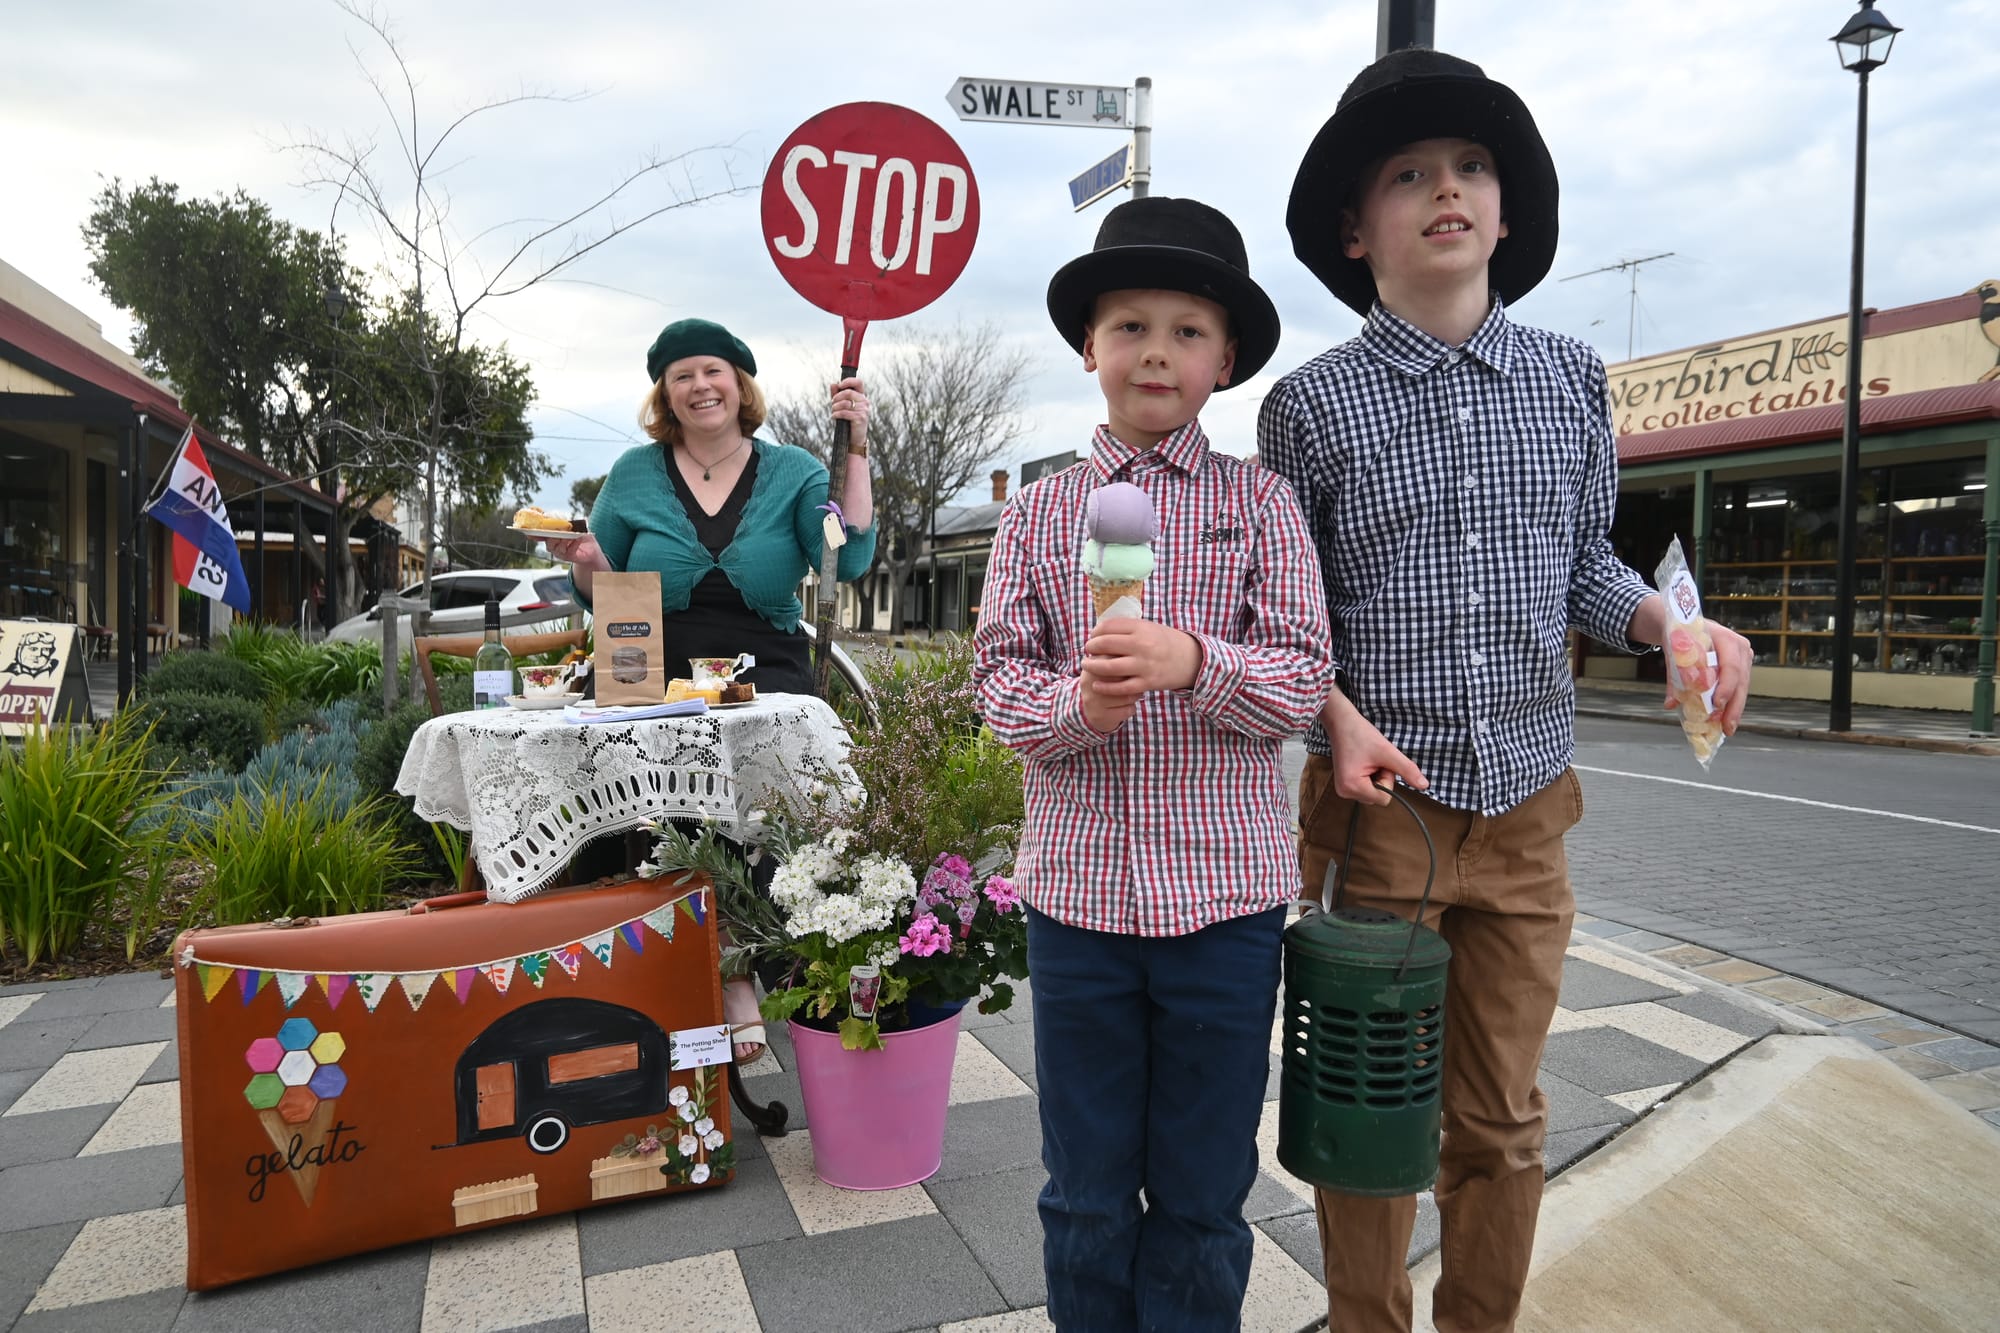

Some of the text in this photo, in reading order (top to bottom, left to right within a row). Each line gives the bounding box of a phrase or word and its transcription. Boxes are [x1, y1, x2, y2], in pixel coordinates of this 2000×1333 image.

[961, 83, 1084, 119] SWALE ST
[1075, 152, 1124, 201] TOILETS
[773, 144, 968, 275] STOP
[1619, 413, 1634, 436] &
[0, 694, 52, 716] OPEN
[246, 1121, 367, 1202] gelato
